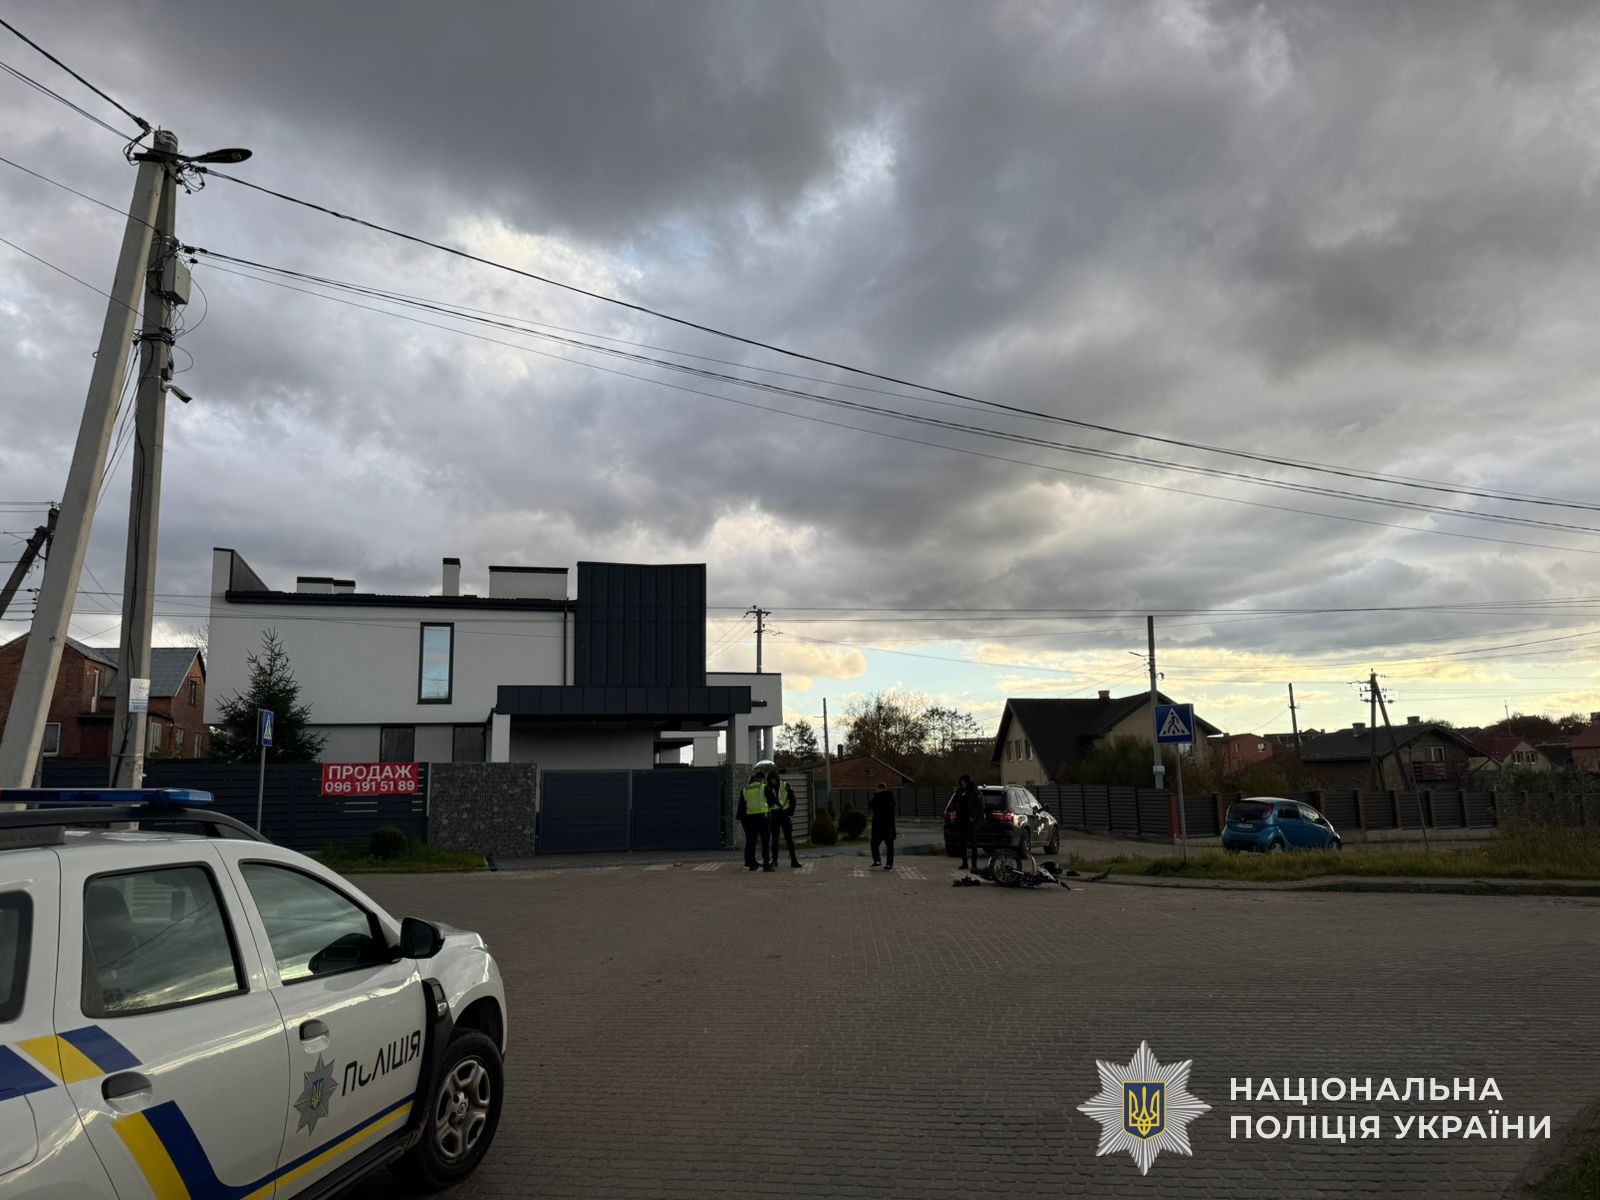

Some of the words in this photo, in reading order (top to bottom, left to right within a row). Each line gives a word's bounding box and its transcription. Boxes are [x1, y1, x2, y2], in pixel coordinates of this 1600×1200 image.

[328, 765, 412, 782] ПРОДАЖ
[325, 781, 352, 792] 096
[355, 781, 376, 792] 191
[380, 781, 394, 791] 51
[398, 780, 415, 791] 89
